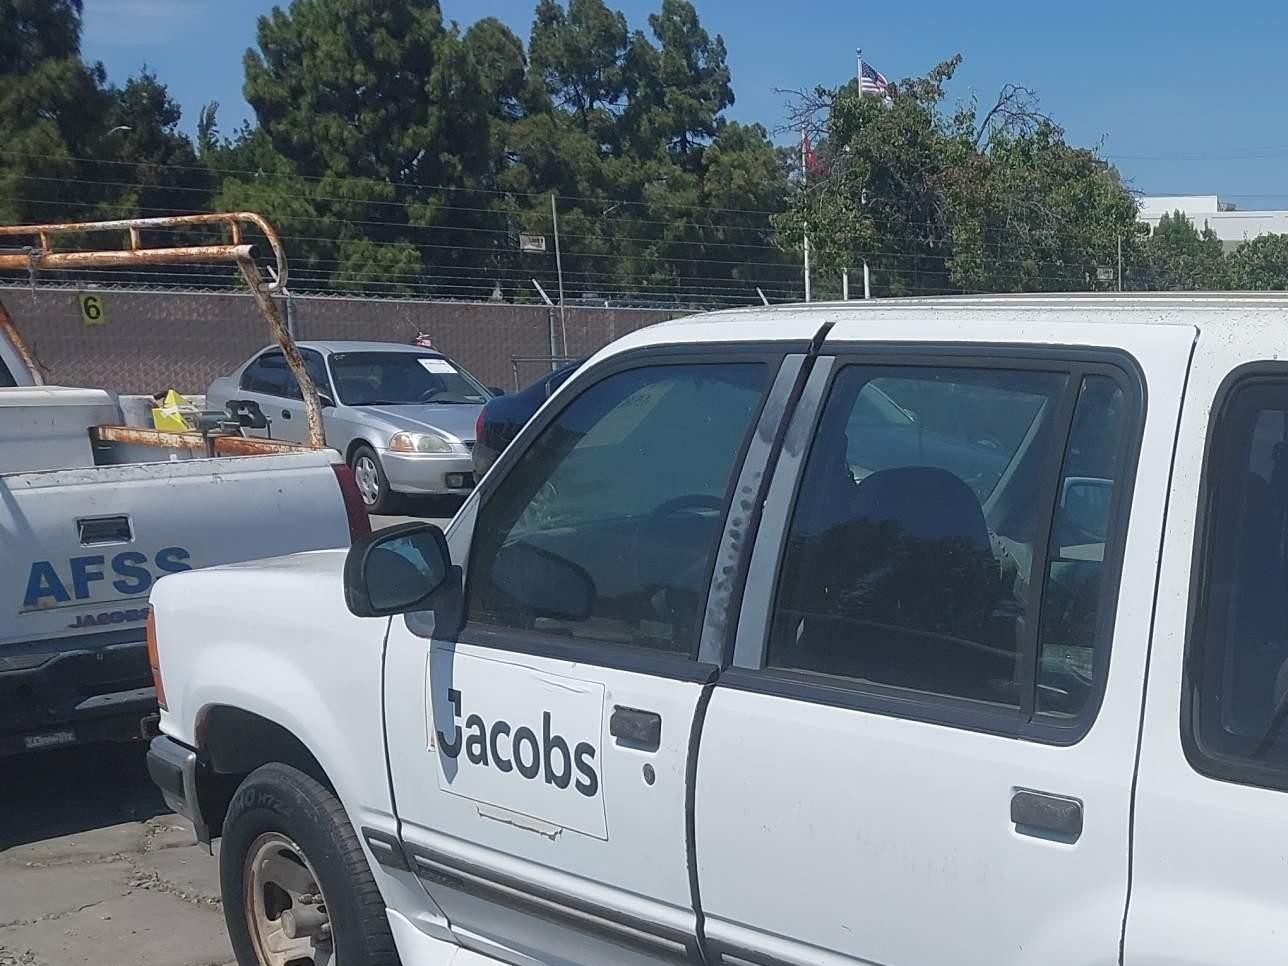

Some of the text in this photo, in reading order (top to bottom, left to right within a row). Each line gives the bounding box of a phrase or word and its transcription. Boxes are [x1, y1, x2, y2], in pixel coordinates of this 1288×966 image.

[83, 295, 101, 320] 6
[22, 546, 193, 607] AFSS
[436, 687, 600, 798] Jacobs
